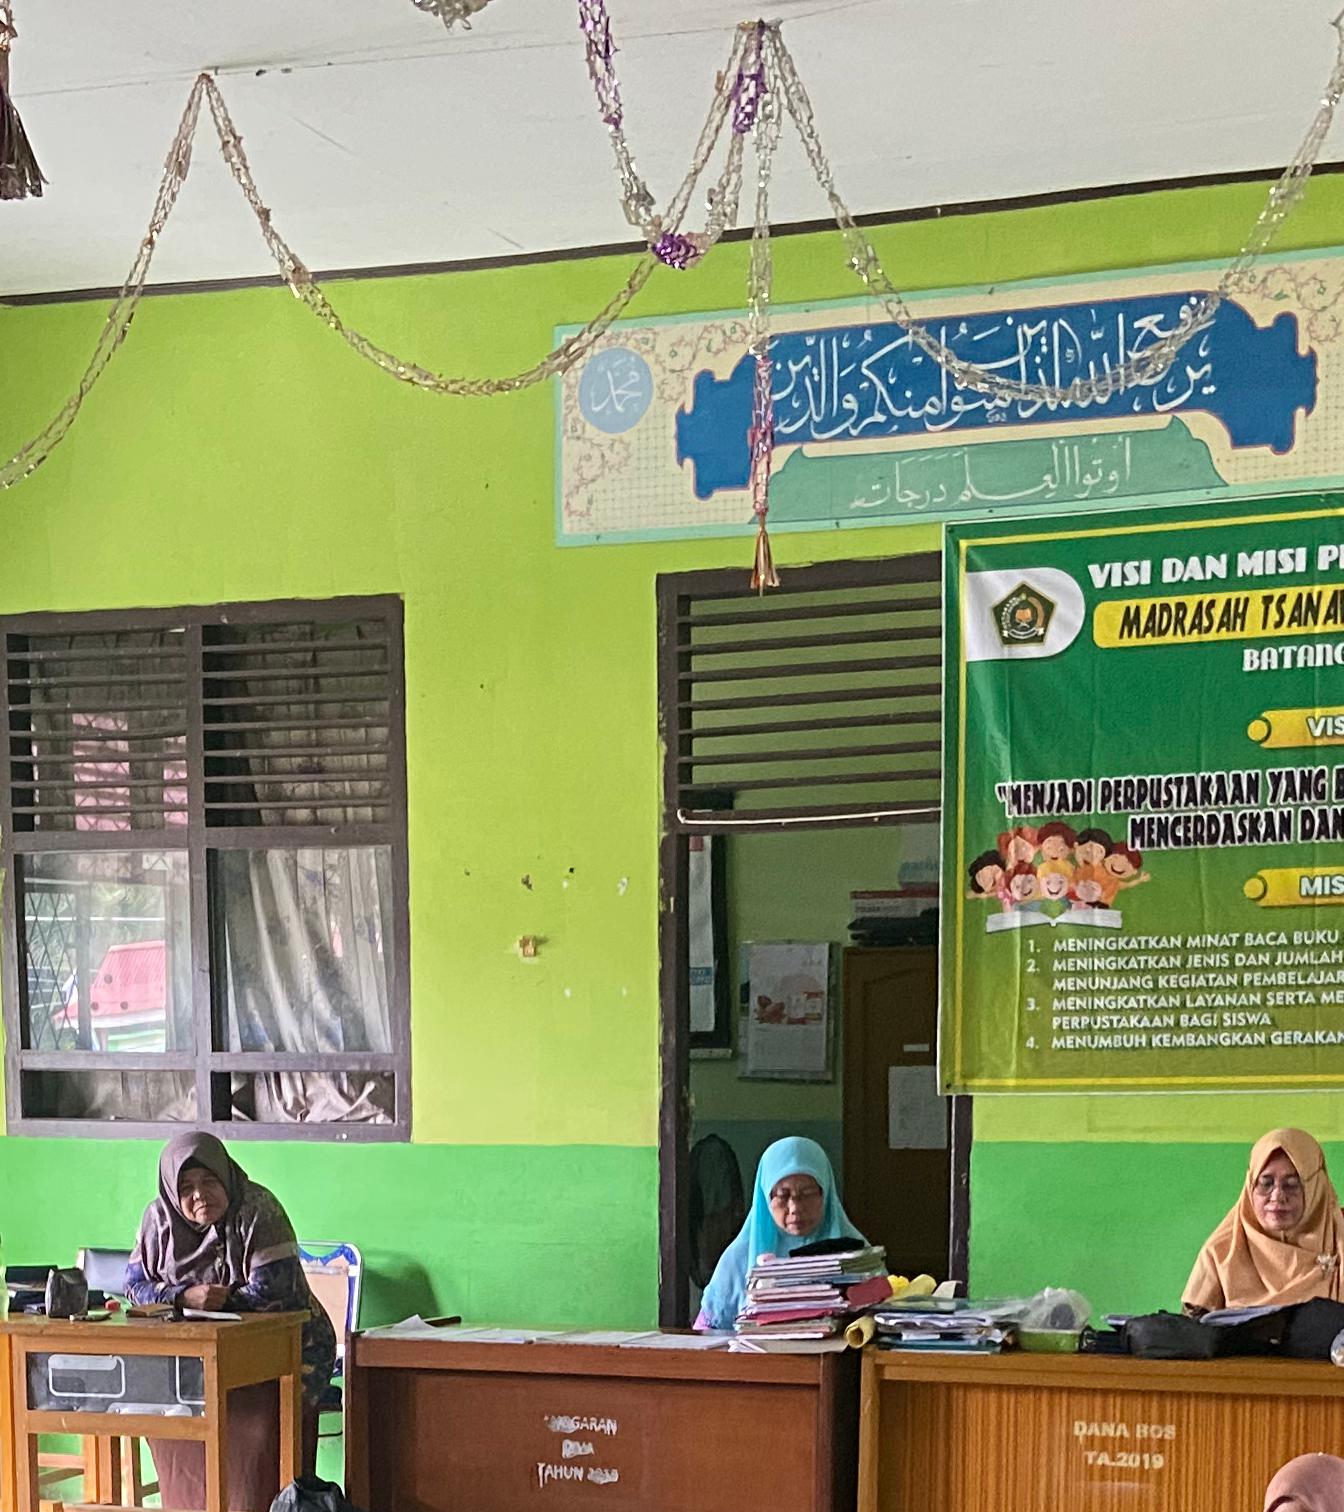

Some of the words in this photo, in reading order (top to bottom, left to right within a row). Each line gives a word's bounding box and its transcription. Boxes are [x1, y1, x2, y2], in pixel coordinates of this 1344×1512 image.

[1088, 559, 1151, 588] VISI
[1162, 553, 1231, 583] DAN
[1237, 547, 1307, 578] MISI
[1119, 596, 1248, 640] MADRASAH
[1098, 769, 1260, 813] PERPUSTAKAAN
[1267, 765, 1329, 805] YANG
[1127, 809, 1294, 851] MENCERDASKAN
[1027, 939, 1041, 953] 1.
[1053, 935, 1182, 952] MENINGKATKAN
[1186, 933, 1239, 949] MINAT
[1244, 931, 1288, 947] BACA
[1293, 929, 1339, 945] BUKU
[1026, 959, 1040, 973] 2.
[1053, 955, 1181, 972] MENINGKATKAN
[1186, 953, 1229, 969] JENIS
[1234, 951, 1270, 967] DAN
[1275, 949, 1343, 966] JUMLAH
[1053, 975, 1154, 991] MENUNJANG
[1158, 973, 1238, 989] KEGIATAN
[1026, 997, 1040, 1011] 3.
[1053, 995, 1180, 1011] MENINGKATKAN
[1186, 993, 1261, 1008] LAYANAN
[1266, 991, 1315, 1006] SERTA
[1052, 1013, 1174, 1030] PERPUSTAKAAN
[1179, 1012, 1218, 1027] BAGI
[1223, 1011, 1271, 1026] SISWA
[1026, 1037, 1039, 1049] 4.
[1052, 1034, 1146, 1049] MENUMBUH
[1151, 1032, 1266, 1048] KEMBANGKAN
[1073, 1420, 1130, 1443] DANA
[1136, 1423, 1176, 1440] BOS
[537, 1462, 584, 1488] TAHUN
